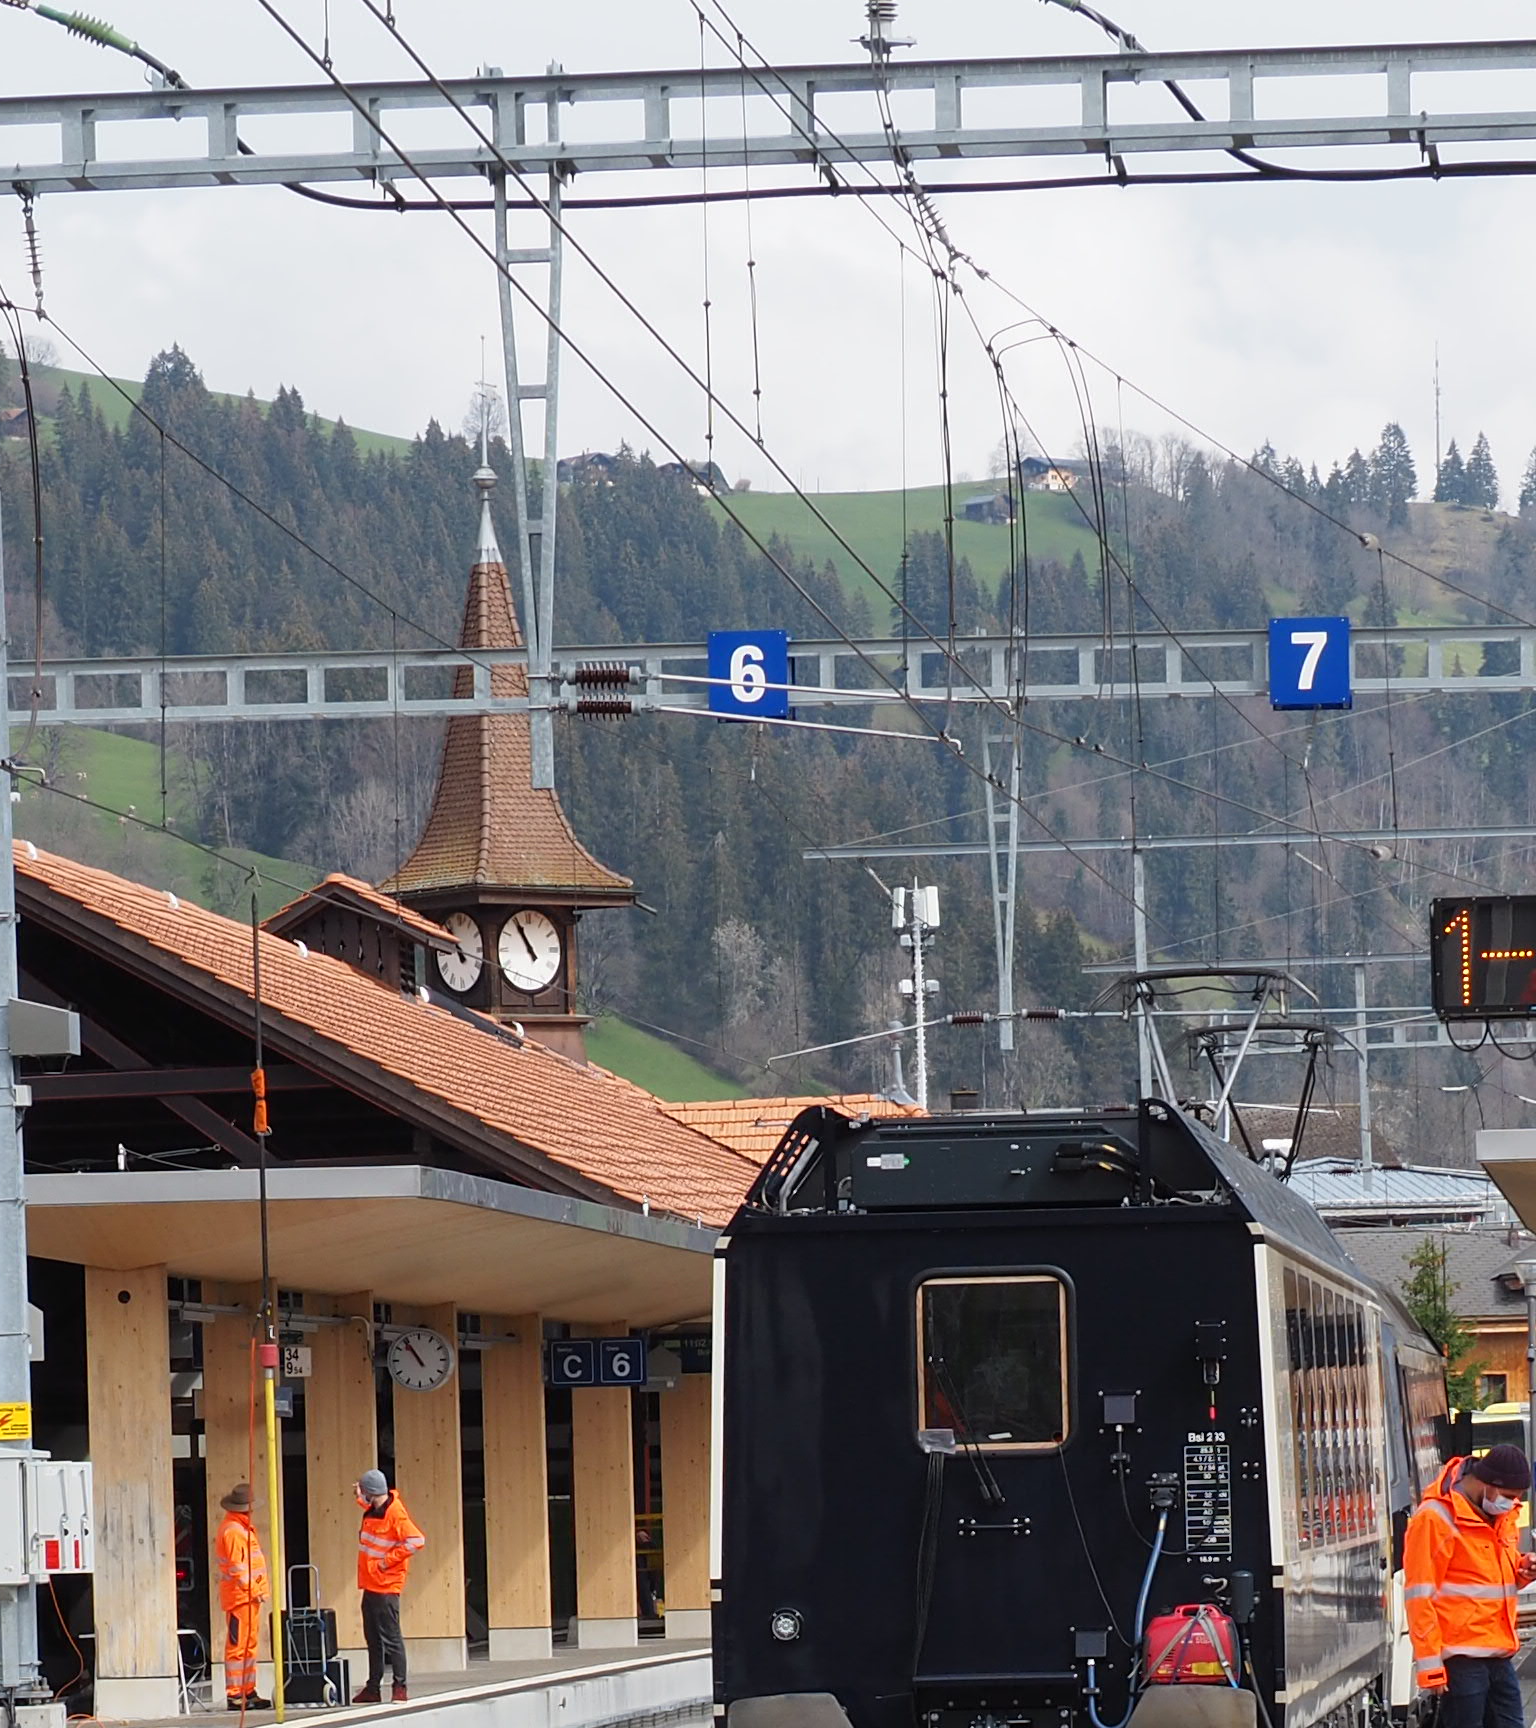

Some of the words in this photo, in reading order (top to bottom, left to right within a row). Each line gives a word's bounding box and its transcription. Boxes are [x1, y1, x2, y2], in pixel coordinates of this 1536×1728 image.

[1290, 631, 1328, 691] 7
[729, 645, 766, 703] 6
[286, 1348, 299, 1361] 34
[563, 1354, 583, 1378] C
[612, 1352, 631, 1377] 6
